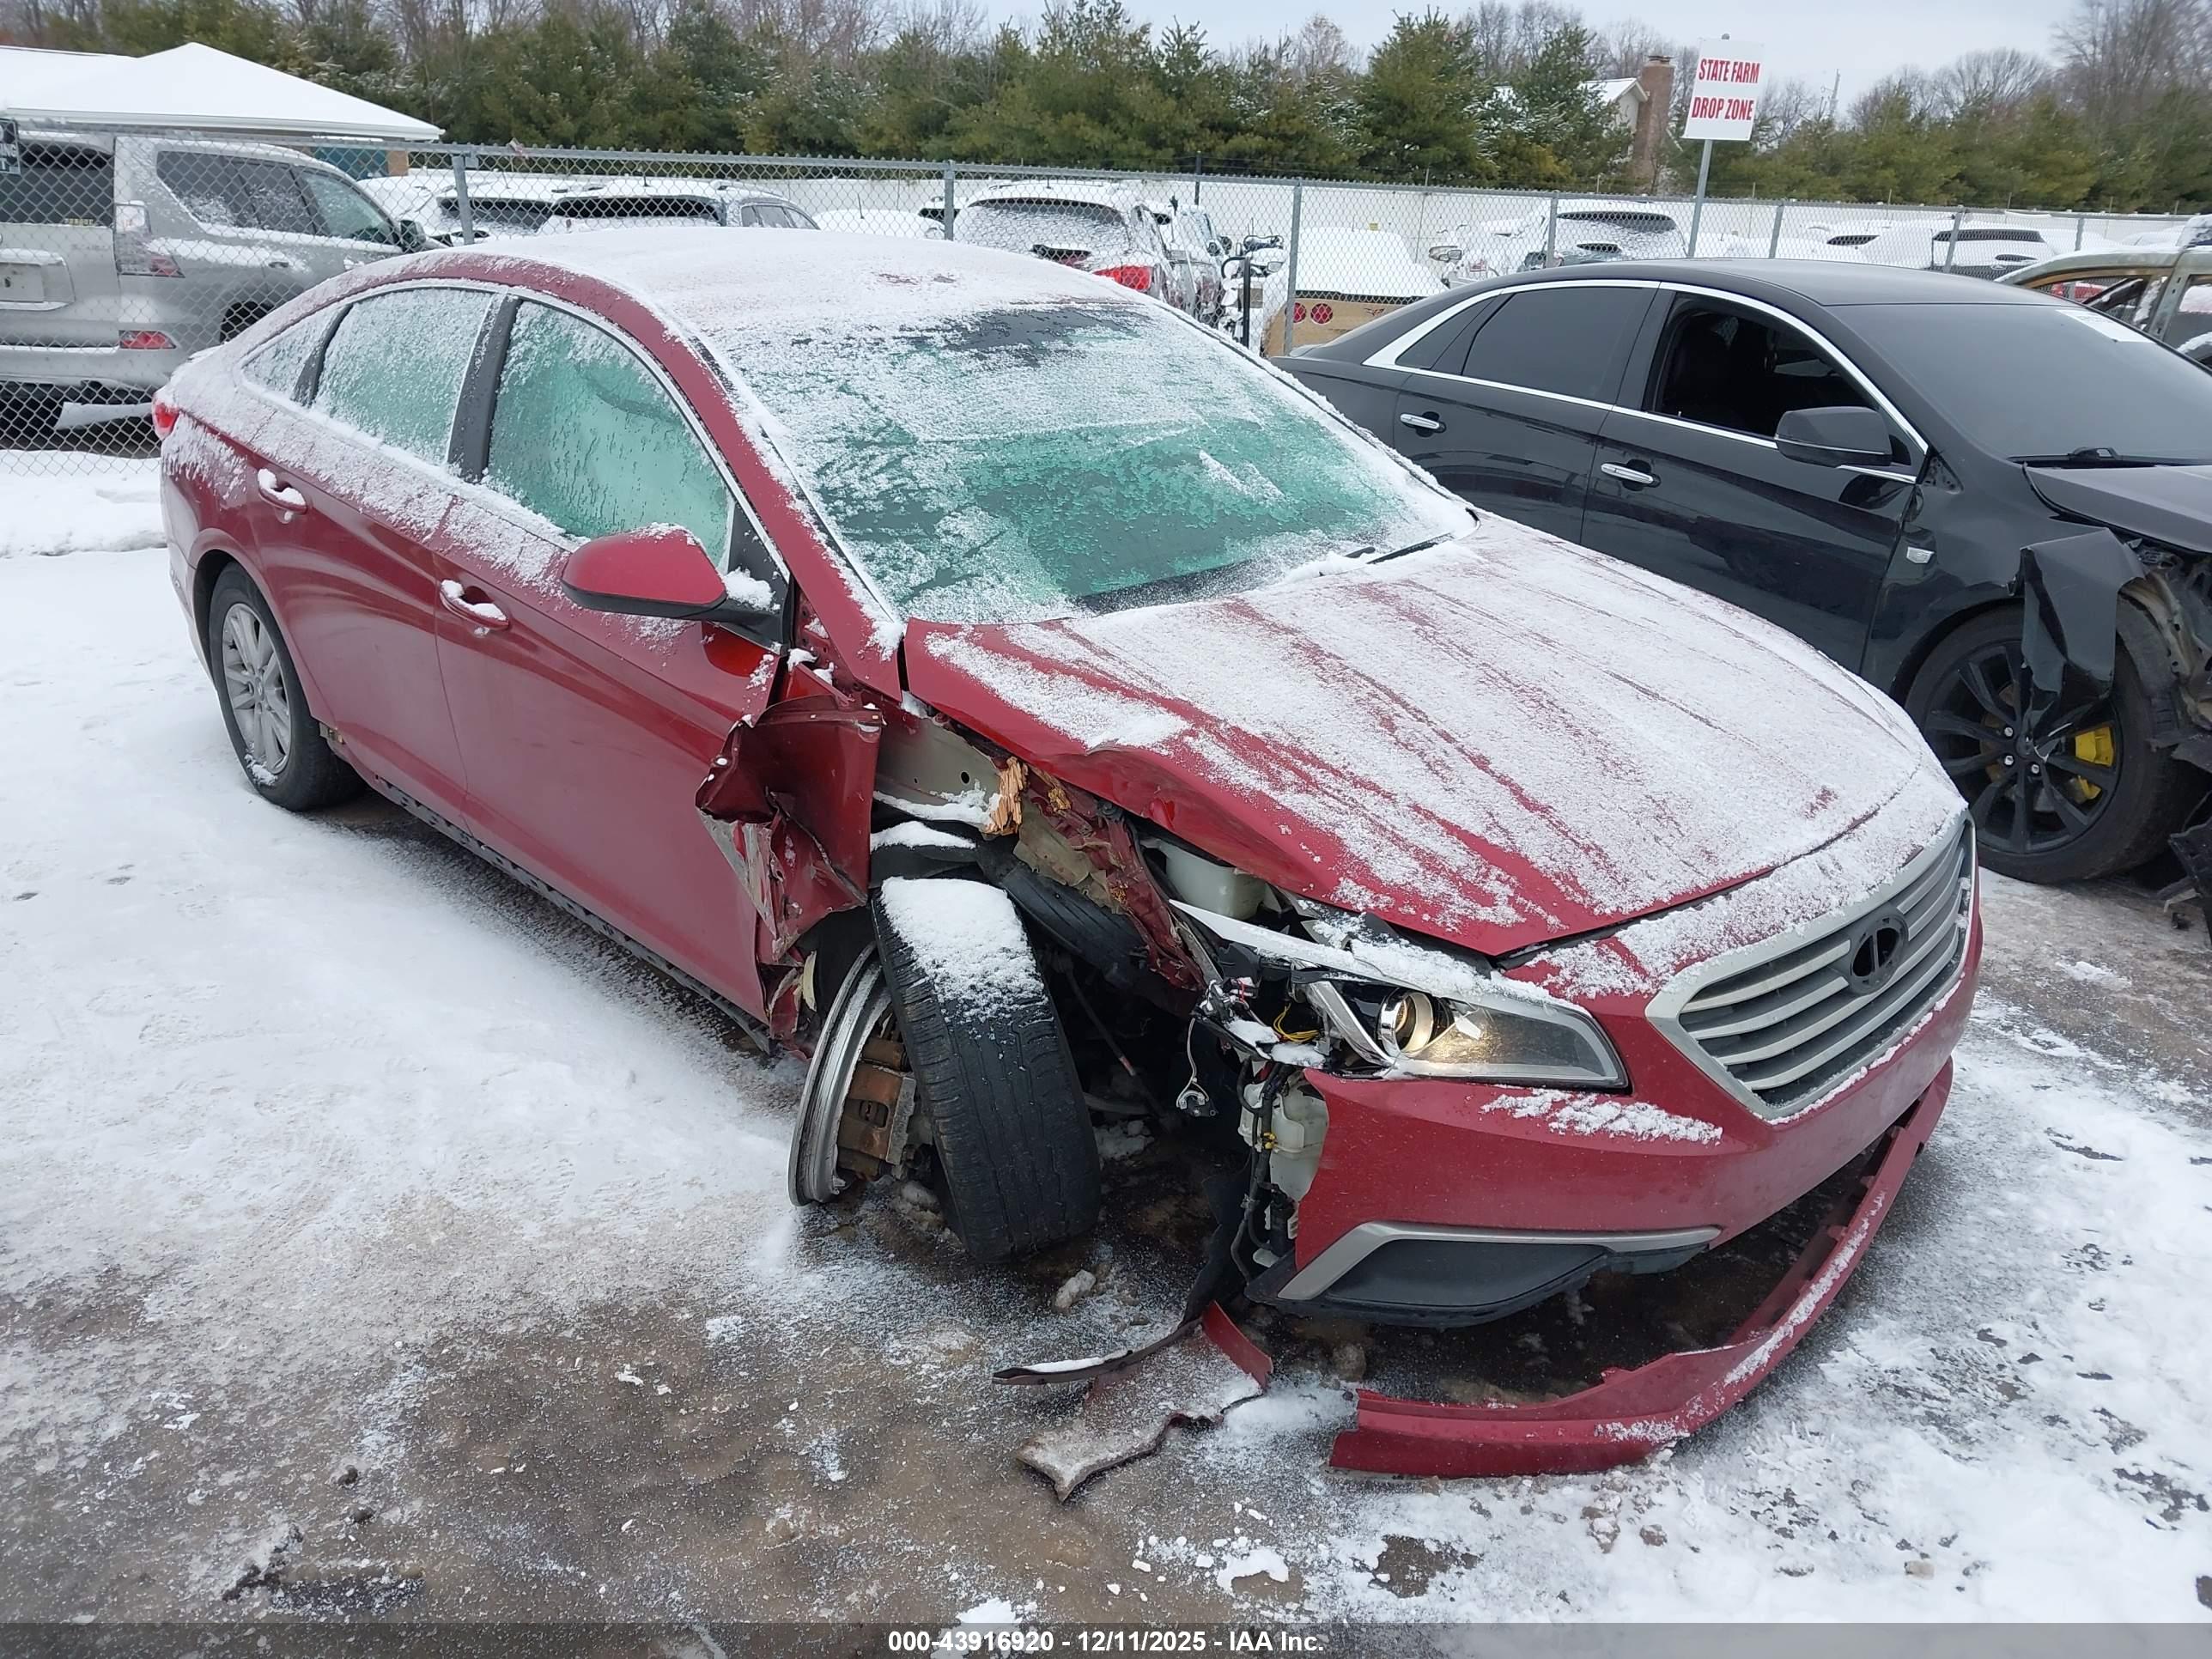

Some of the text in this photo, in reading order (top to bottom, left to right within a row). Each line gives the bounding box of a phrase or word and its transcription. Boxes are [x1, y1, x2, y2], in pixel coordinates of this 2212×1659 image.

[1698, 58, 1760, 83] STATE FARM
[1692, 97, 1754, 120] DROP ZONE
